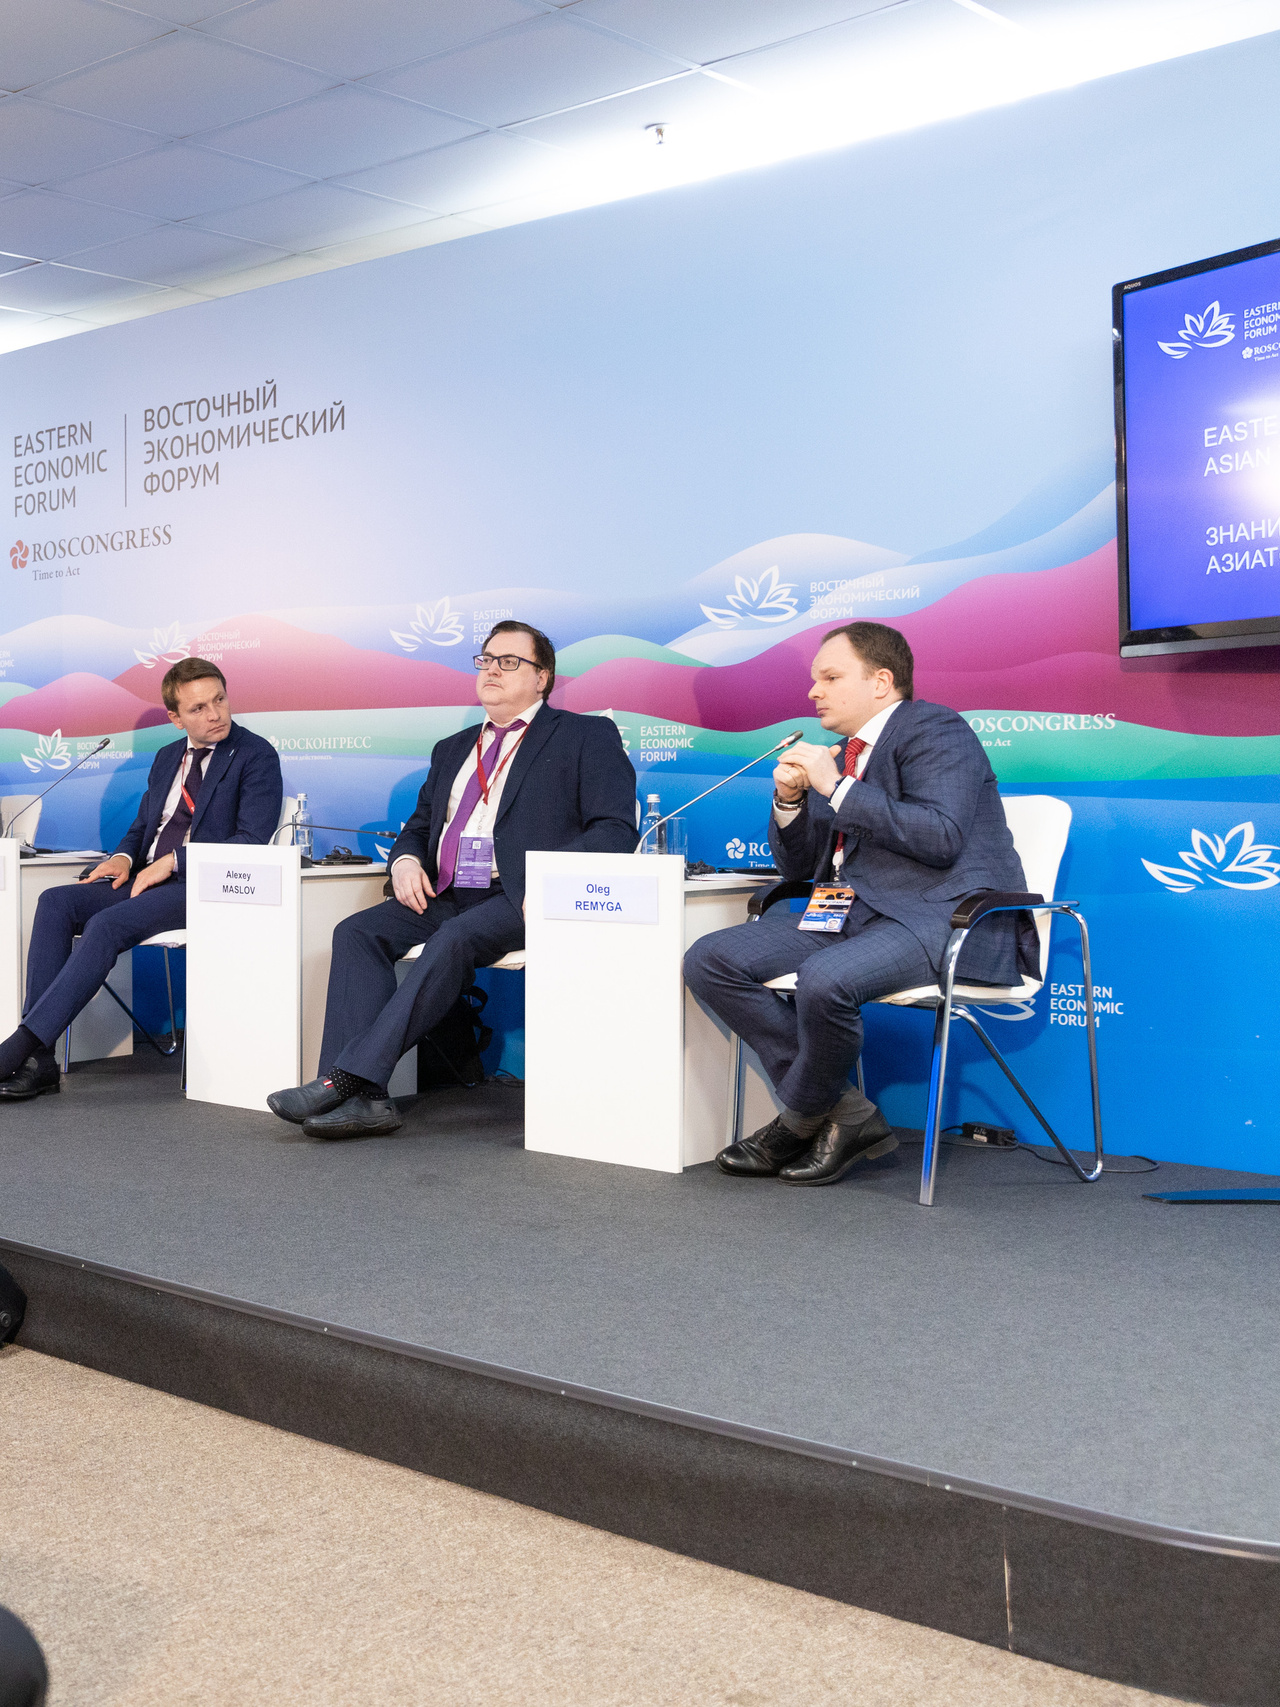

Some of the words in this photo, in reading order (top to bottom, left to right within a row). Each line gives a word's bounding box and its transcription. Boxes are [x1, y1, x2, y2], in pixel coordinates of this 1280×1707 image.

[1123, 281, 1142, 290] AQUOS
[1243, 324, 1277, 340] FORUM
[144, 379, 277, 432] ВОСТОЧНЫЙ
[14, 420, 92, 458] EASTERN
[143, 400, 345, 464] ЭКОНОМИЧЕСКИЙ
[1204, 414, 1280, 448] EASTE
[14, 449, 108, 488] ECONOMIC
[1203, 446, 1271, 477] ASIAN
[143, 461, 219, 496] ФОРУМ
[14, 486, 76, 518] FORUM
[1205, 516, 1280, 547] ЗНАНИ
[31, 524, 172, 562] ROSCONGRESS
[1206, 546, 1280, 575] АЗИАТ
[32, 569, 53, 581] Time
[55, 569, 64, 578] to
[65, 566, 80, 577] Act
[809, 574, 885, 593] ВОСТОЧНЫЙ
[809, 585, 920, 607] ЭКОНОМИЧЕСКИЙ
[473, 608, 513, 621] EASTERN
[809, 606, 853, 620] ФОРУМ
[197, 629, 240, 642] ВОСТОЧНЫЙ
[197, 638, 261, 653] ЭКОНОМИЧЕСКИЙ
[640, 725, 686, 737] EASTERN
[969, 713, 1116, 733] OSCONGRESS
[281, 736, 372, 751] РОСКОНГРЕСС
[640, 737, 695, 749] ECONOMIC
[982, 739, 993, 747] to
[994, 738, 1012, 747] Act
[640, 751, 677, 762] FORUM
[225, 870, 252, 882] Alexey
[222, 884, 256, 895] MASLOV
[586, 883, 610, 896] Oleg
[575, 900, 622, 912] REMYGA
[1050, 983, 1113, 999] EASTRN
